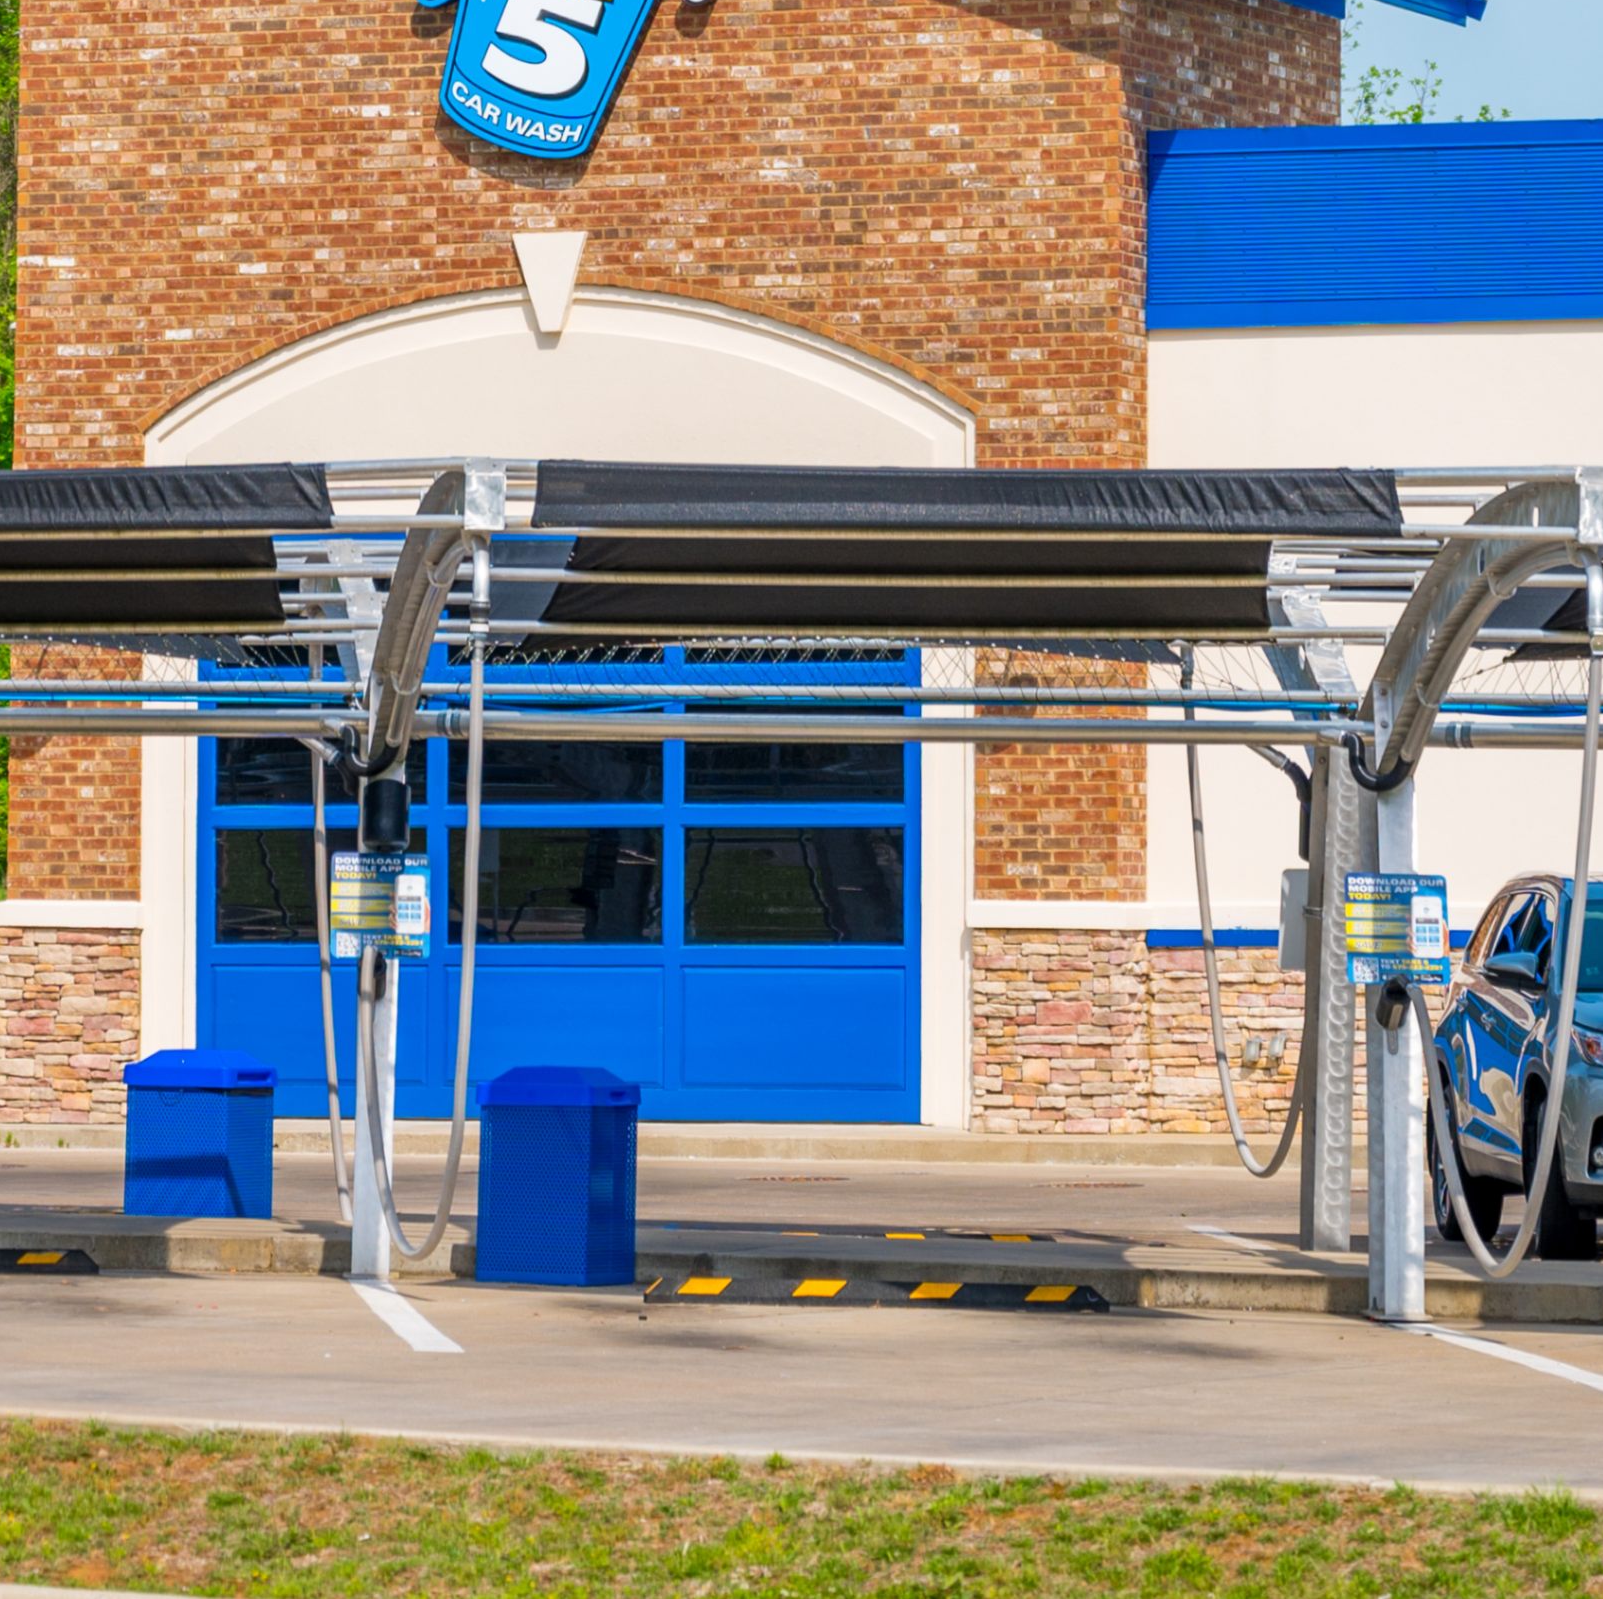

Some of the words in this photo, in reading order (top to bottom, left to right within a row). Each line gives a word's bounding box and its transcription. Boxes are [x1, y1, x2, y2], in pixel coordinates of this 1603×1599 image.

[452, 81, 501, 125] CAR
[505, 112, 584, 143] WASH
[335, 856, 401, 865] DOWNLOAD
[380, 865, 402, 873] APP
[1348, 877, 1416, 886] DOWNLOAD
[1420, 879, 1444, 887] OUR
[1348, 885, 1391, 893] MOBILE
